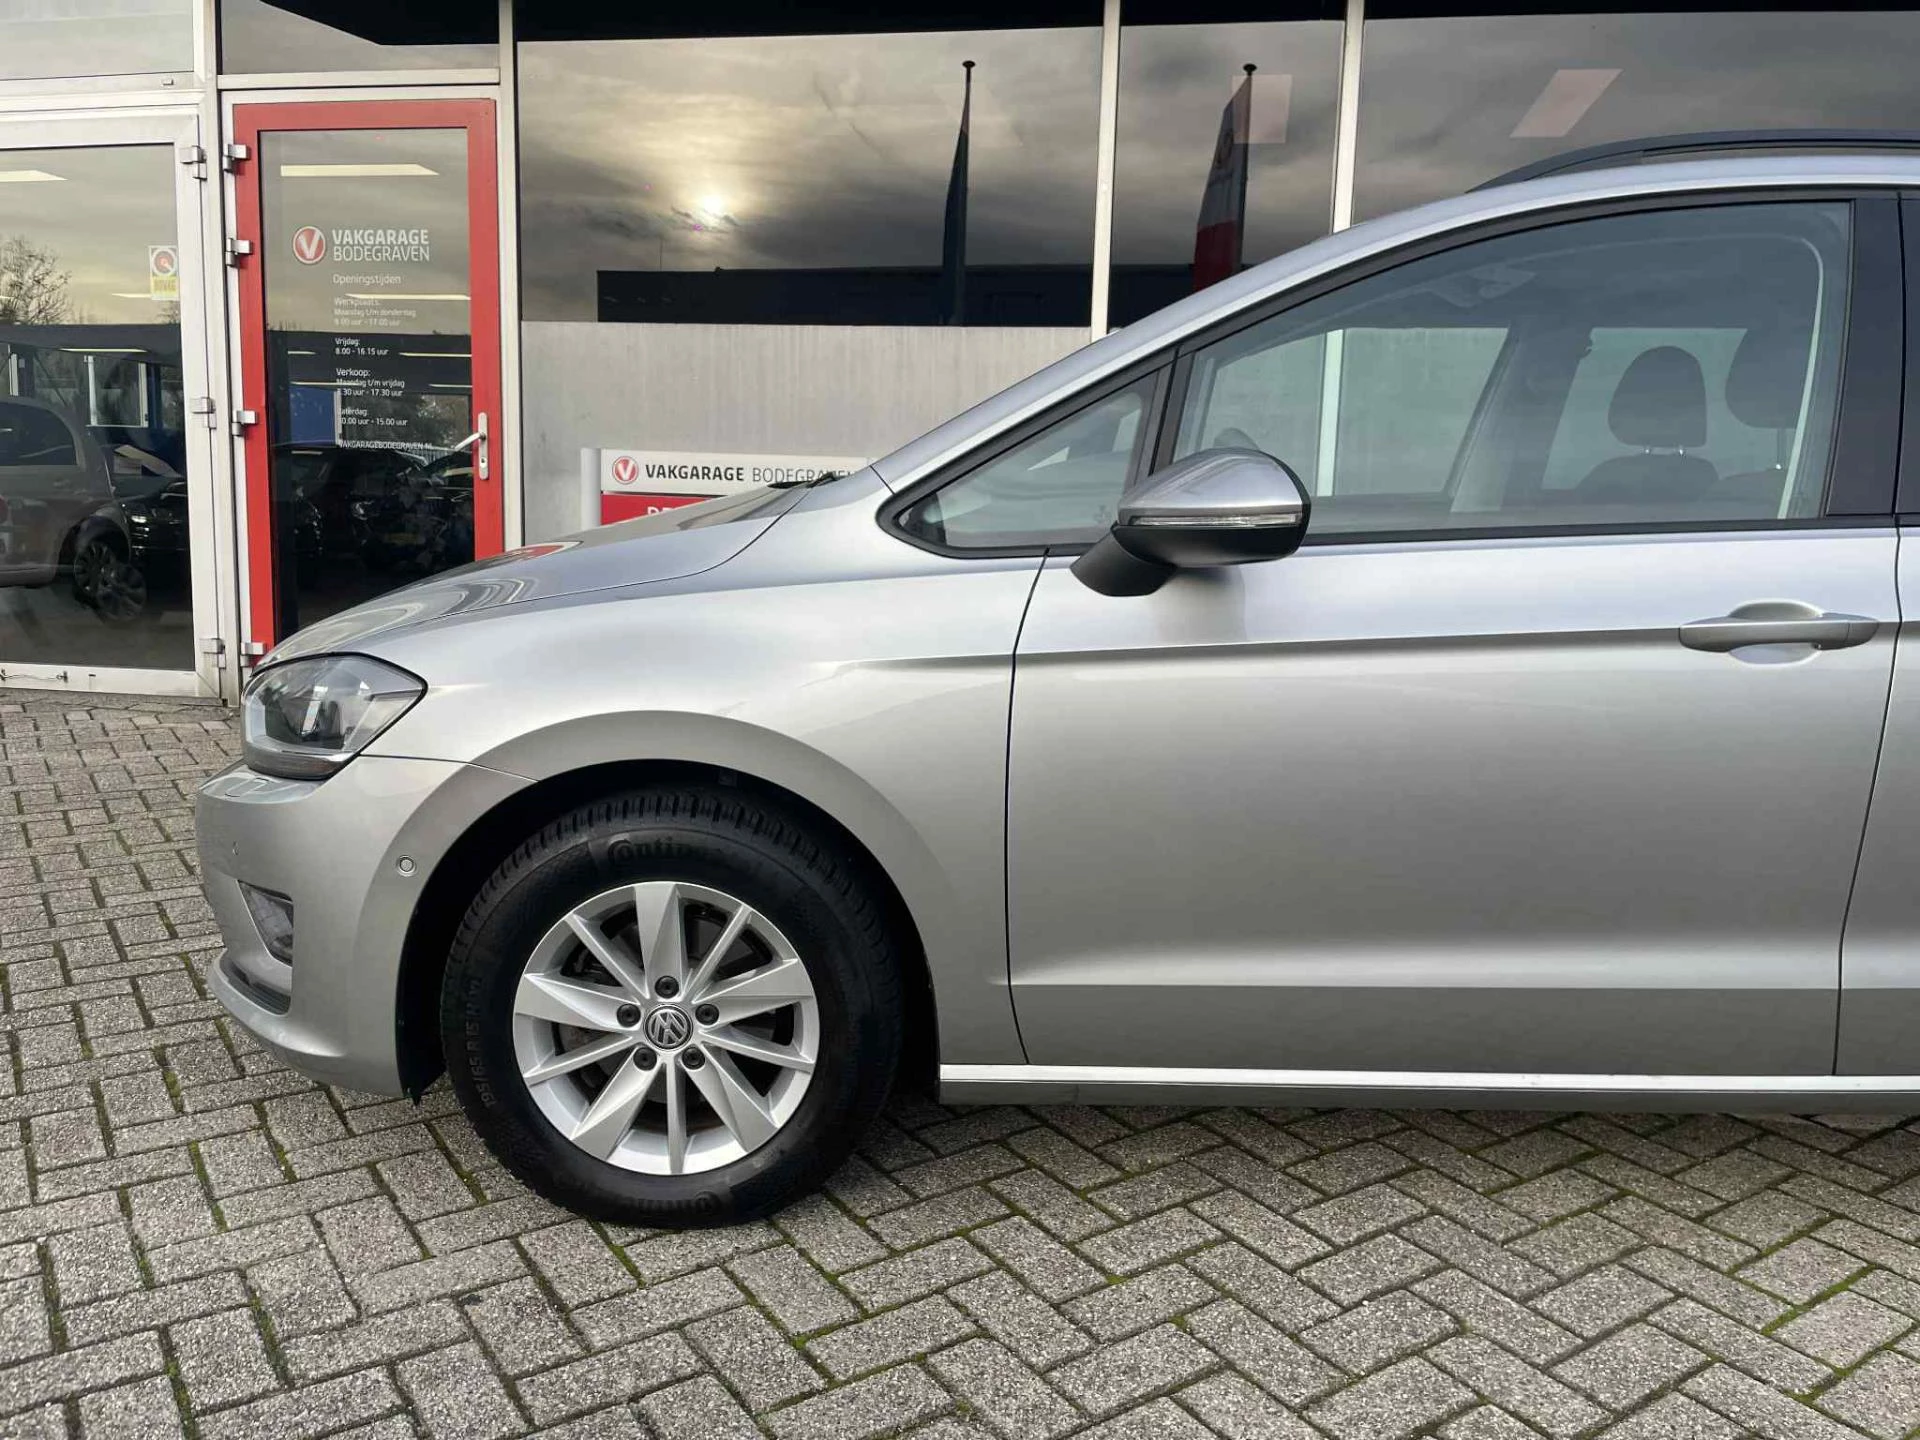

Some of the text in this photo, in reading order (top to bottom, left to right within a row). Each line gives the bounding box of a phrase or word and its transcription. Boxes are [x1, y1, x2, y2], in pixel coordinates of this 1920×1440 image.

[332, 229, 429, 245] VAKGARAGE
[333, 245, 430, 261] BODEGRAVEN
[333, 273, 401, 286] Openingstijden
[335, 337, 360, 347] Vrijdag:
[357, 348, 376, 356] 16.15
[336, 368, 371, 378] Verkoop:
[367, 379, 381, 387] t/m
[382, 379, 405, 389] vrijdag
[371, 389, 390, 397] 17.30
[376, 418, 395, 426] 15.00
[645, 464, 745, 481] VAKGARAGE
